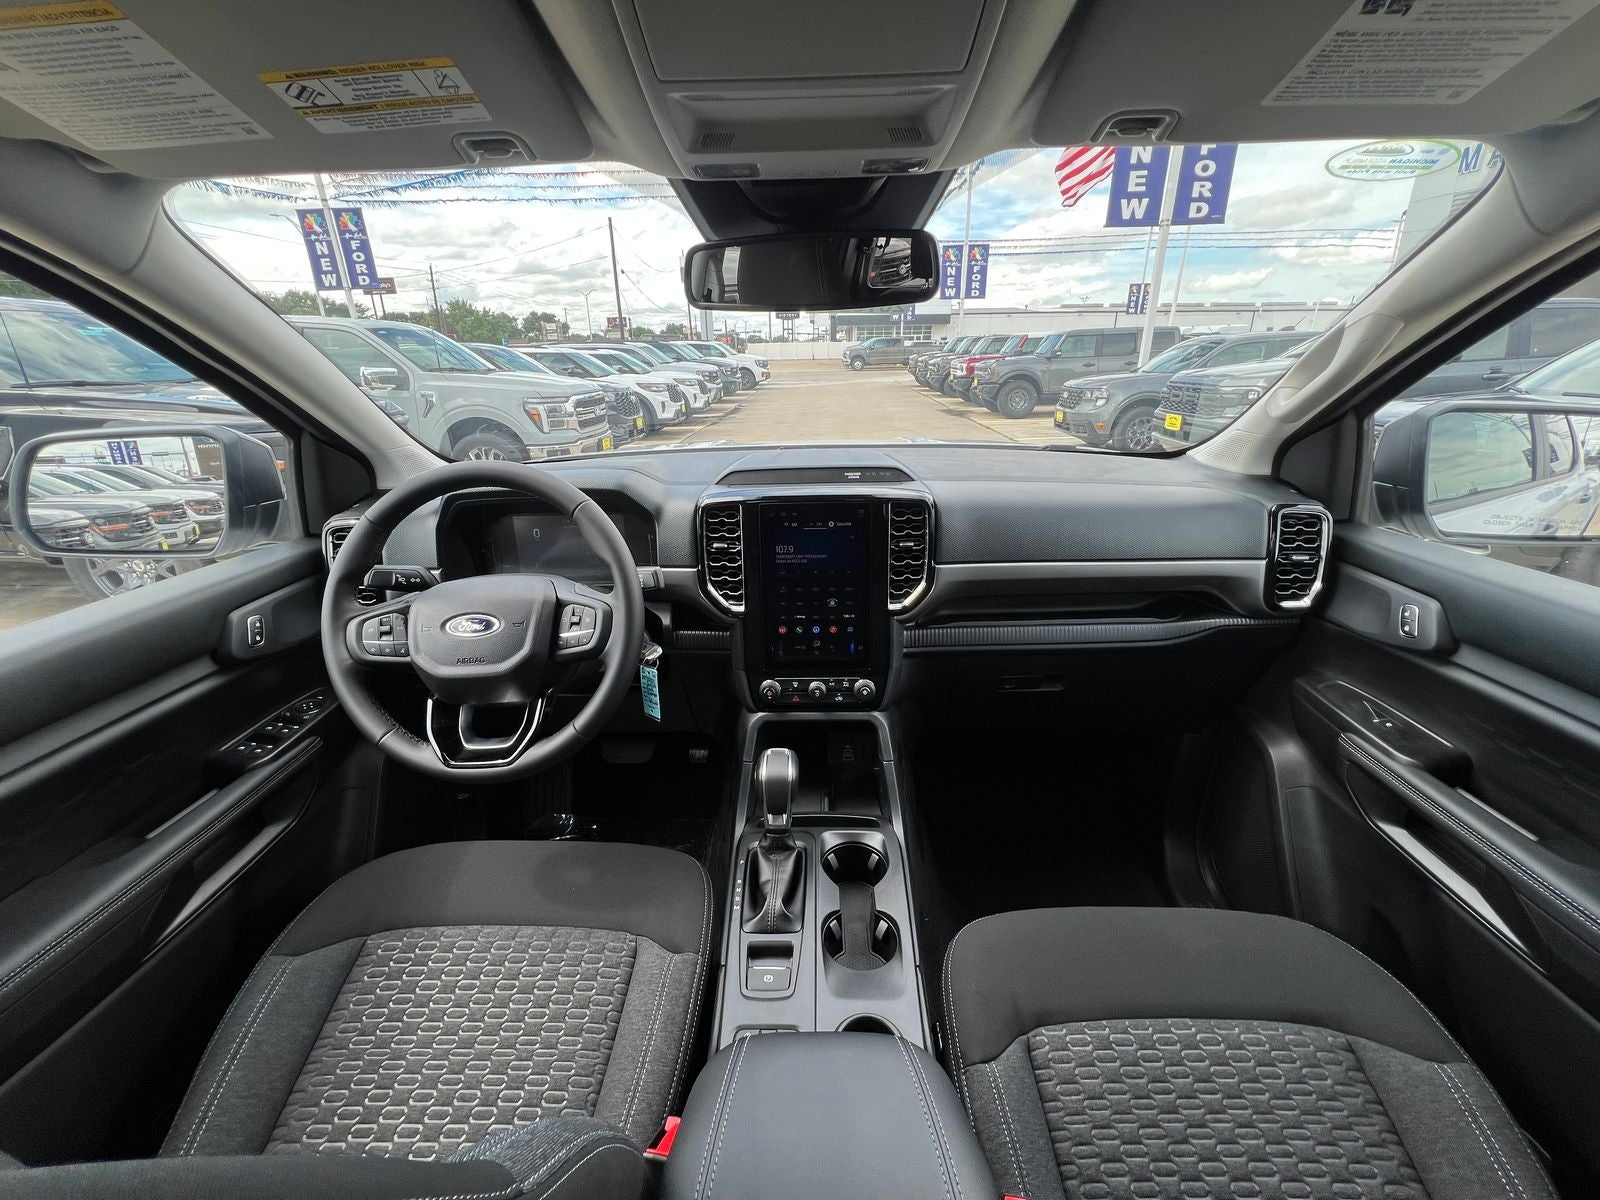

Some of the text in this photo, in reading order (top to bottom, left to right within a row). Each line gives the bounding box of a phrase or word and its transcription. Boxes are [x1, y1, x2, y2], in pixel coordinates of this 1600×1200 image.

[1120, 146, 1153, 220] NEW
[314, 241, 337, 287] NEW
[350, 240, 370, 285] FORD
[944, 266, 957, 297] NEW
[970, 265, 981, 297] FORD
[532, 528, 541, 539] 0
[775, 545, 794, 554] 107.9
[456, 656, 486, 665] AIRBAG
